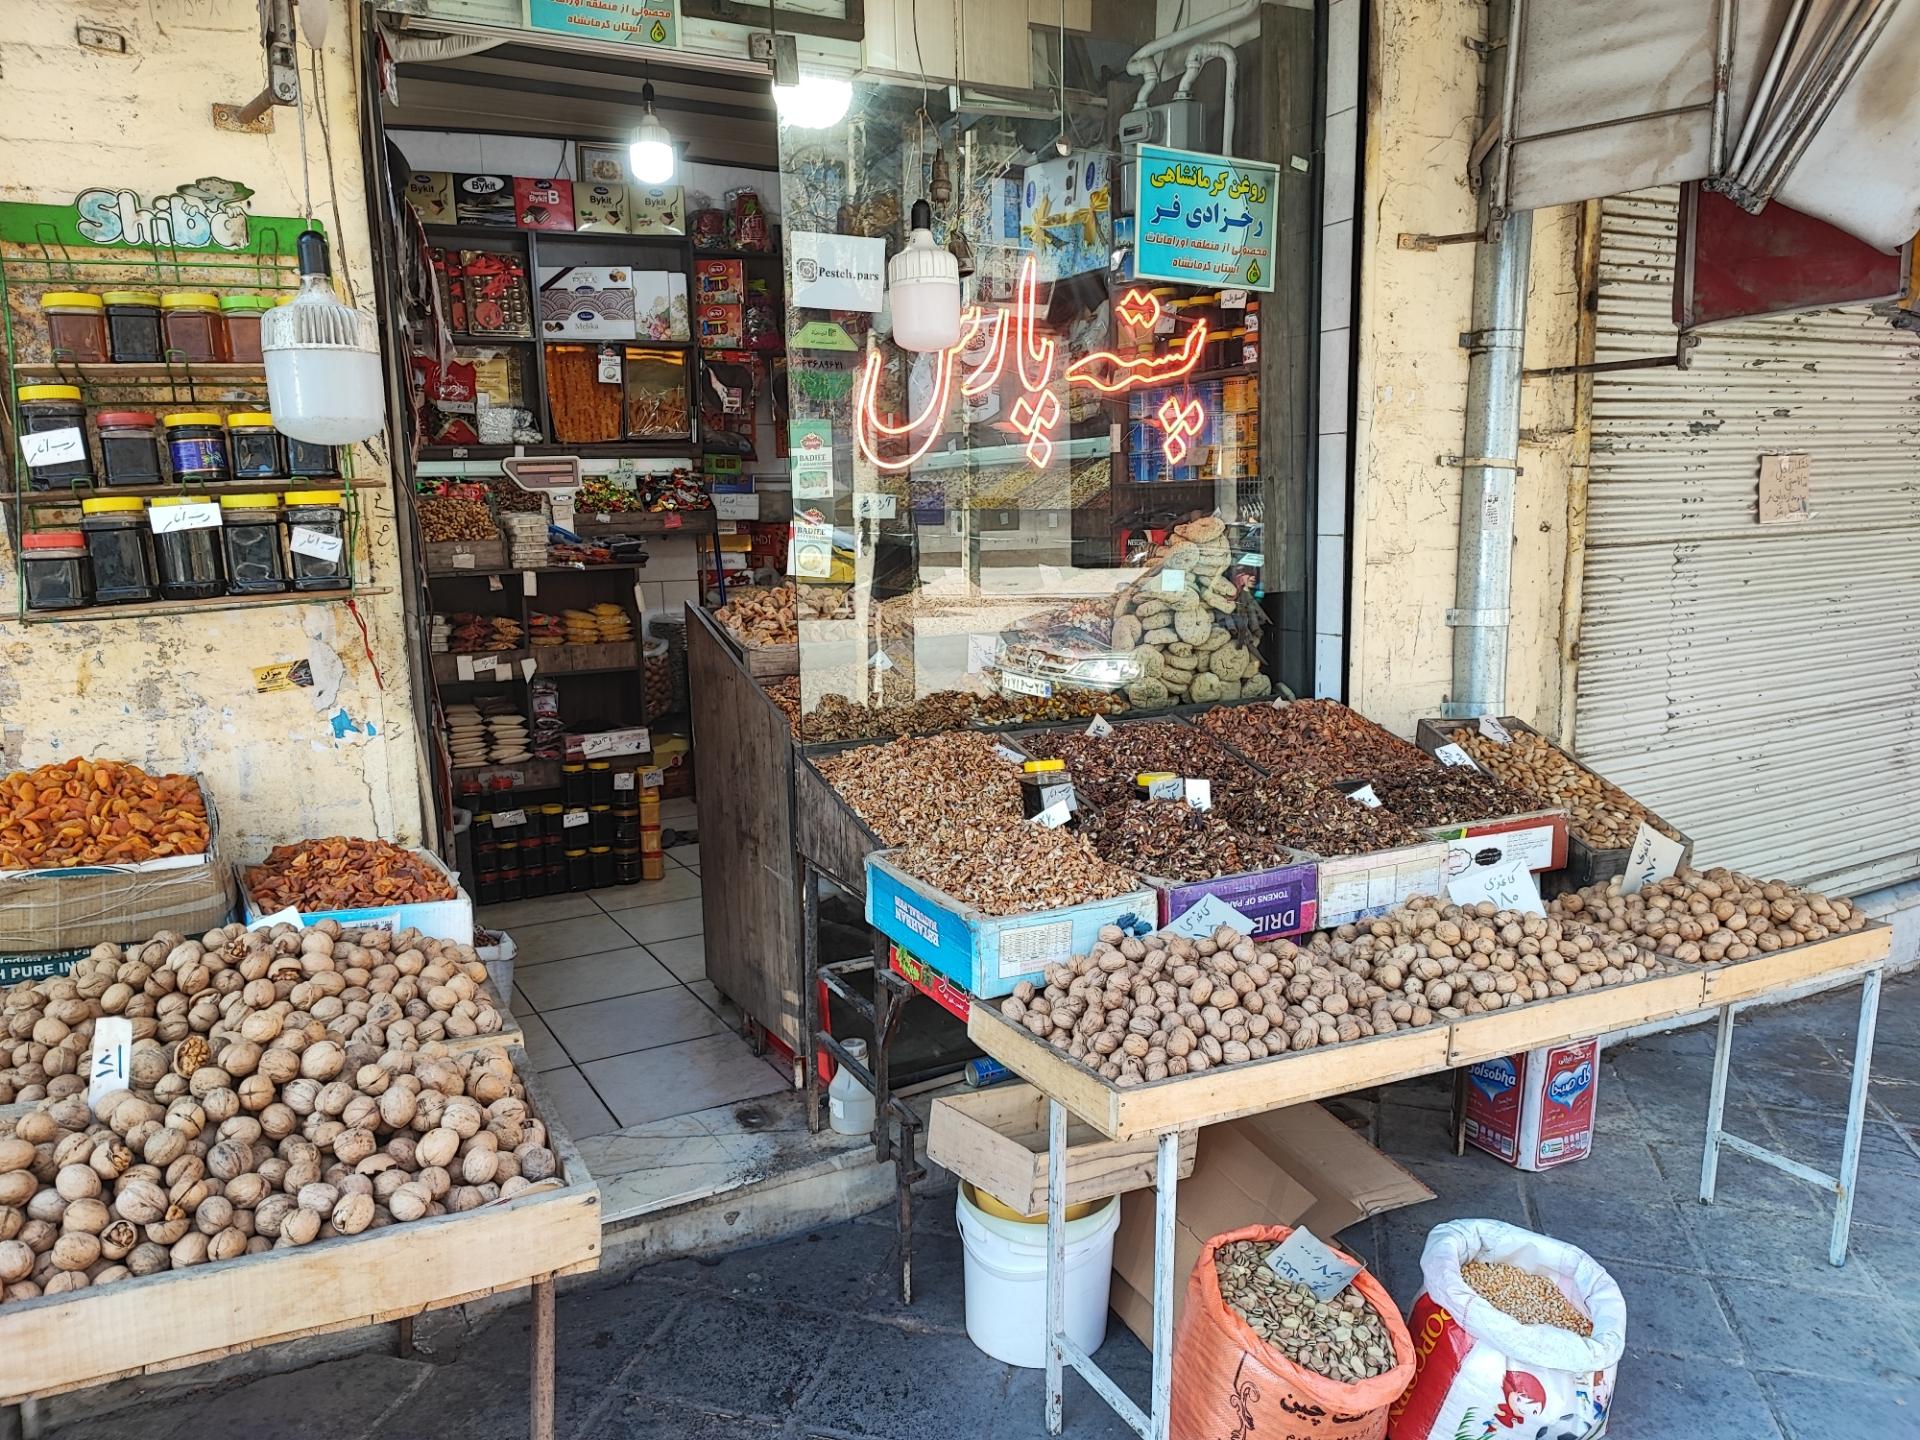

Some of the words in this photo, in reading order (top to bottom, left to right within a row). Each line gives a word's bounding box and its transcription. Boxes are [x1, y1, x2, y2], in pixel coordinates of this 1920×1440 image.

[567, 15, 611, 30] کرمانشاه
[613, 21, 642, 33] استان
[471, 181, 497, 192] Bykit
[1150, 163, 1229, 197] کرمانشاهی
[410, 184, 435, 194] Bykit
[1228, 174, 1267, 204] روغن
[589, 195, 613, 206] Bykit
[644, 197, 667, 208] Bykit
[1150, 193, 1182, 225] فر
[76, 187, 250, 250] Shiba
[1190, 238, 1220, 251] منطقه
[1221, 242, 1231, 253] از
[1231, 243, 1268, 257] محصولی
[1172, 257, 1211, 272] کرمانشاه
[1213, 262, 1240, 274] استان
[856, 252, 1062, 472] پارس
[1064, 287, 1207, 466] پسته
[1484, 861, 1522, 891] کاغذی
[1245, 896, 1256, 906] OF
[1257, 889, 1289, 904] TOKENS
[1487, 892, 1519, 911] ۱۸۰
[1226, 900, 1245, 909] PA
[1253, 909, 1296, 934] DRIE
[10, 962, 55, 979] PURE
[1578, 1063, 1592, 1085] گل
[1278, 1393, 1327, 1427] چین
